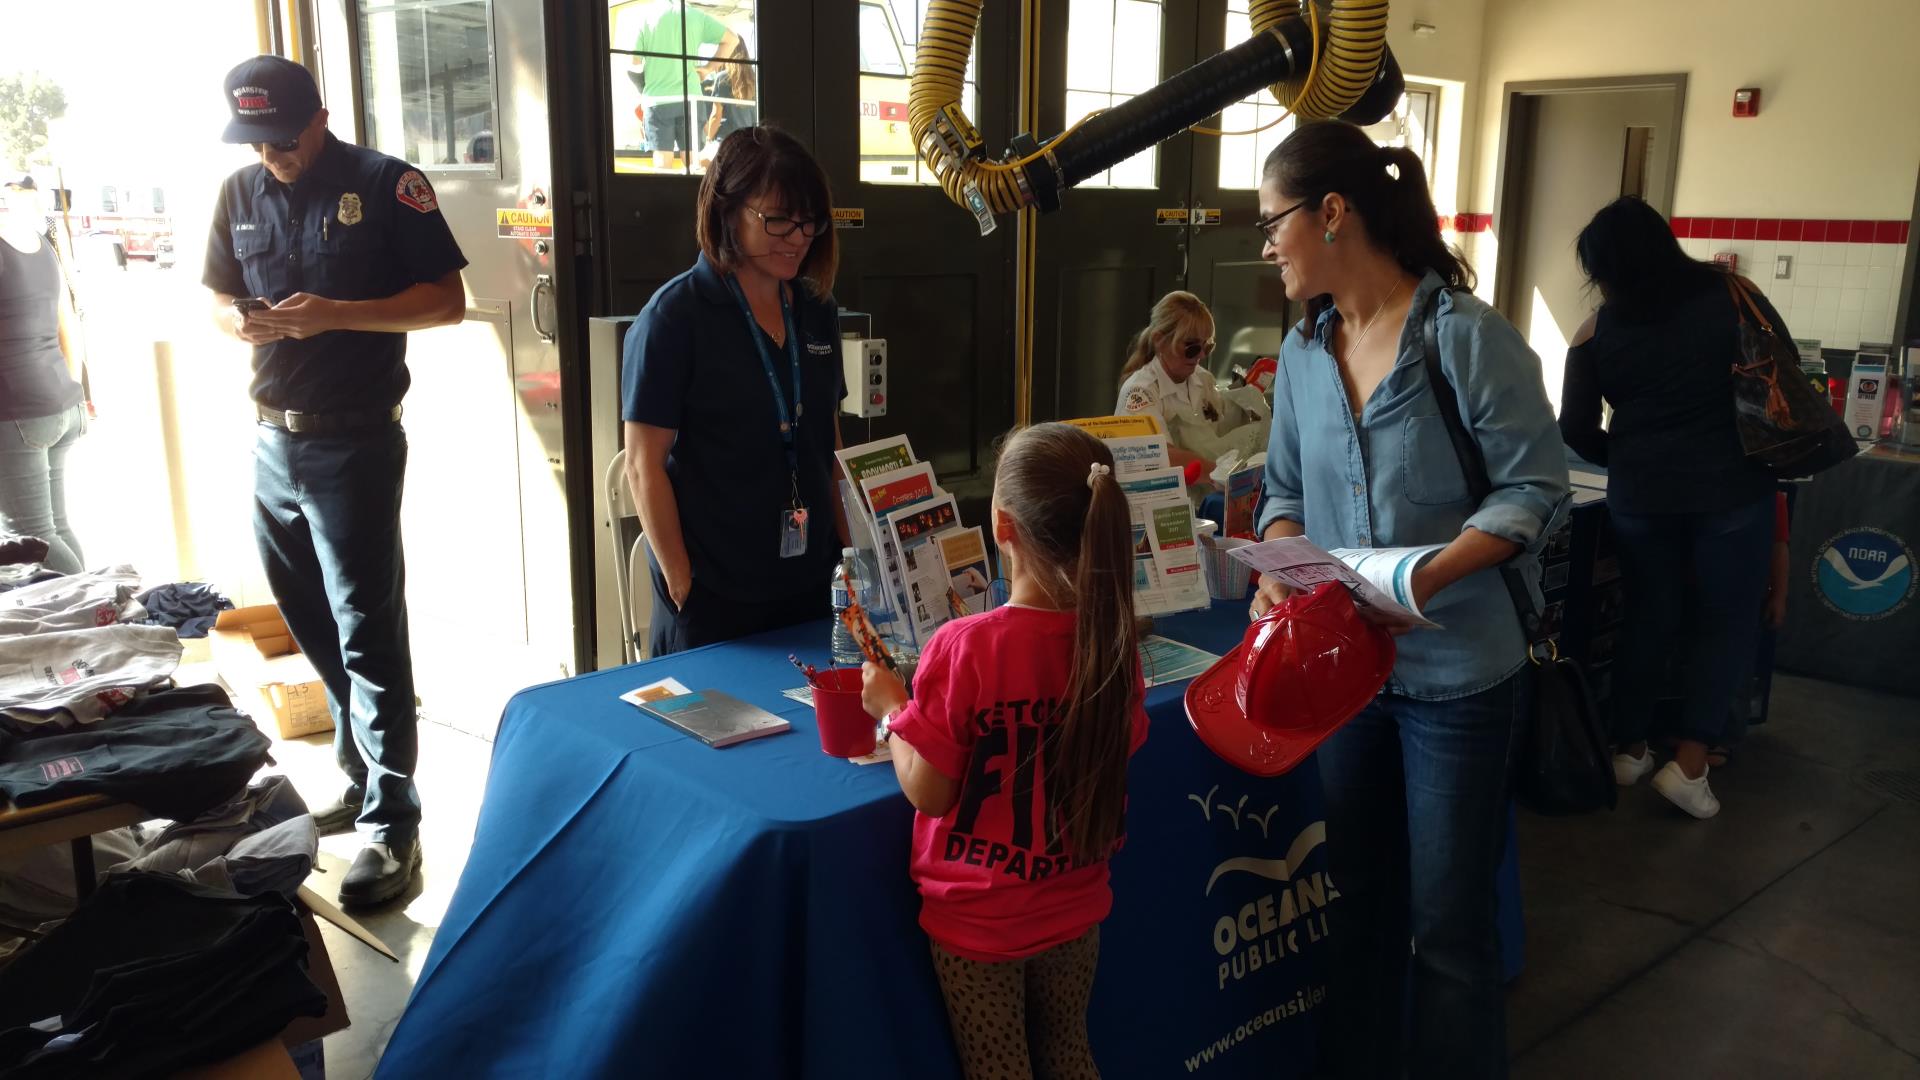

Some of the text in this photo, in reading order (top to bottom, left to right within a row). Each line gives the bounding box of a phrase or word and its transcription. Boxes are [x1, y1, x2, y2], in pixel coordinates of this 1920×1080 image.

[860, 102, 878, 116] RD
[511, 212, 549, 224] CAUTION
[1848, 547, 1887, 563] NOAA
[943, 833, 1105, 881] DEPART
[1218, 929, 1299, 991] PUBLIC
